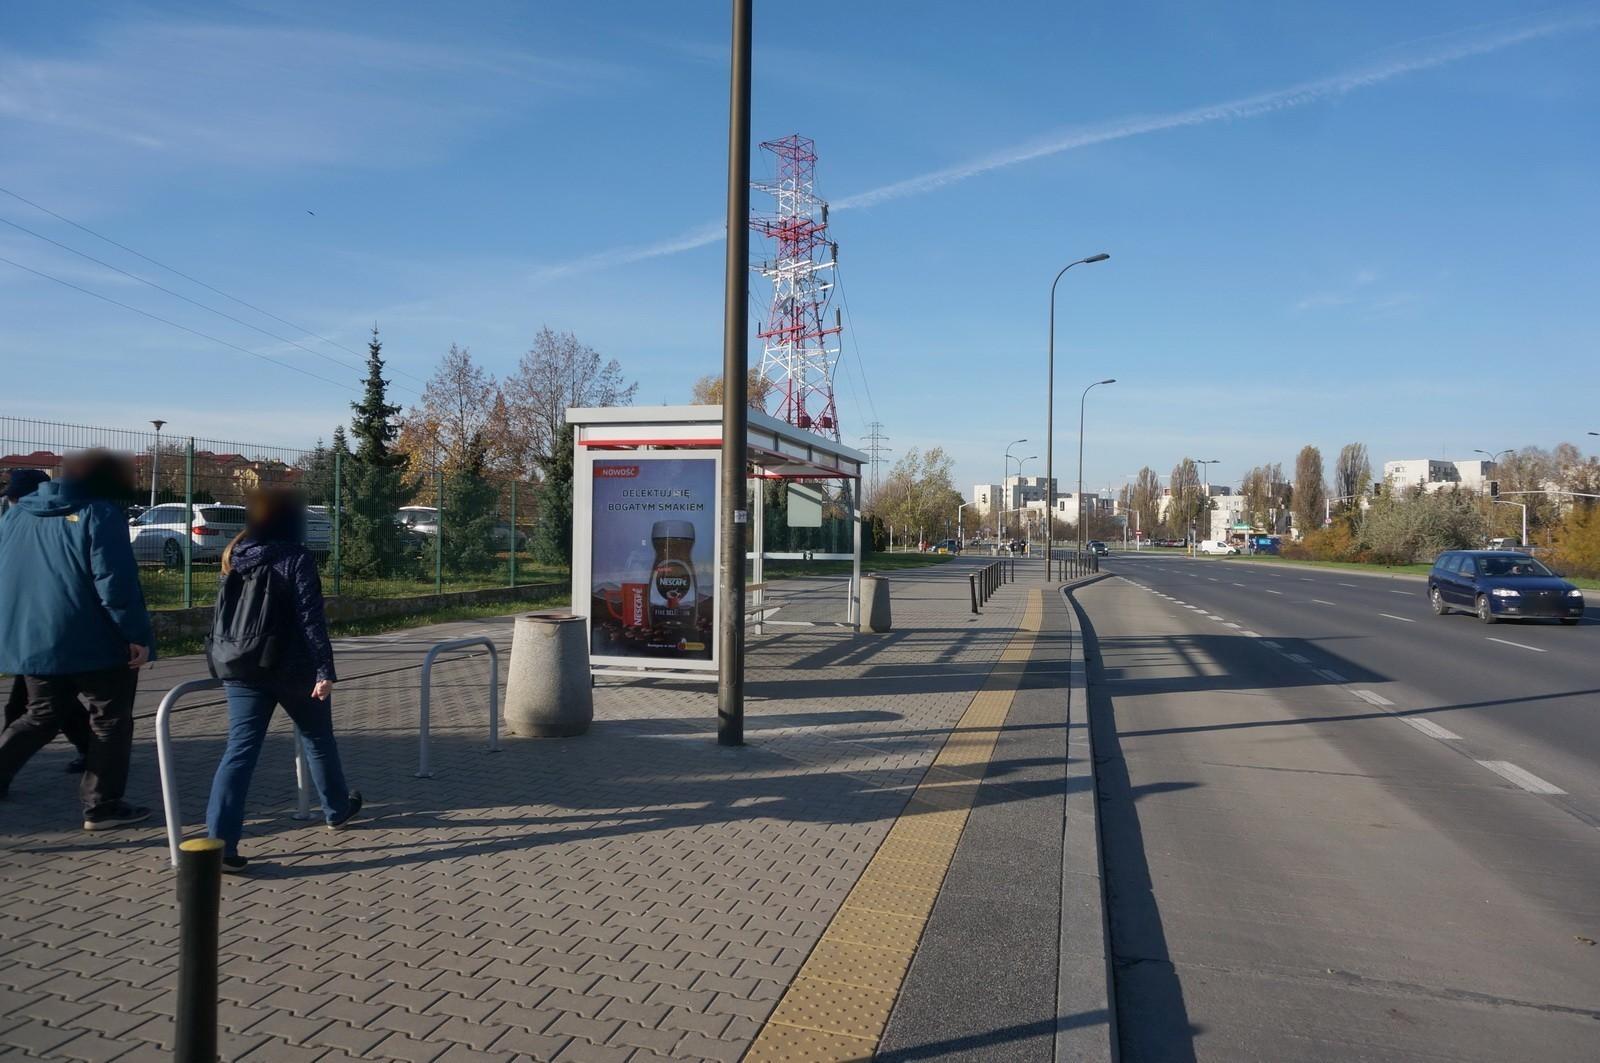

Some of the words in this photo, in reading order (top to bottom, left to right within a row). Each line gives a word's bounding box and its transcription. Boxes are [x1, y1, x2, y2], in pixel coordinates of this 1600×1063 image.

[622, 489, 671, 498] DELEKTUJ
[608, 503, 655, 511] BOGATYM
[658, 503, 704, 511] SMAKIEM
